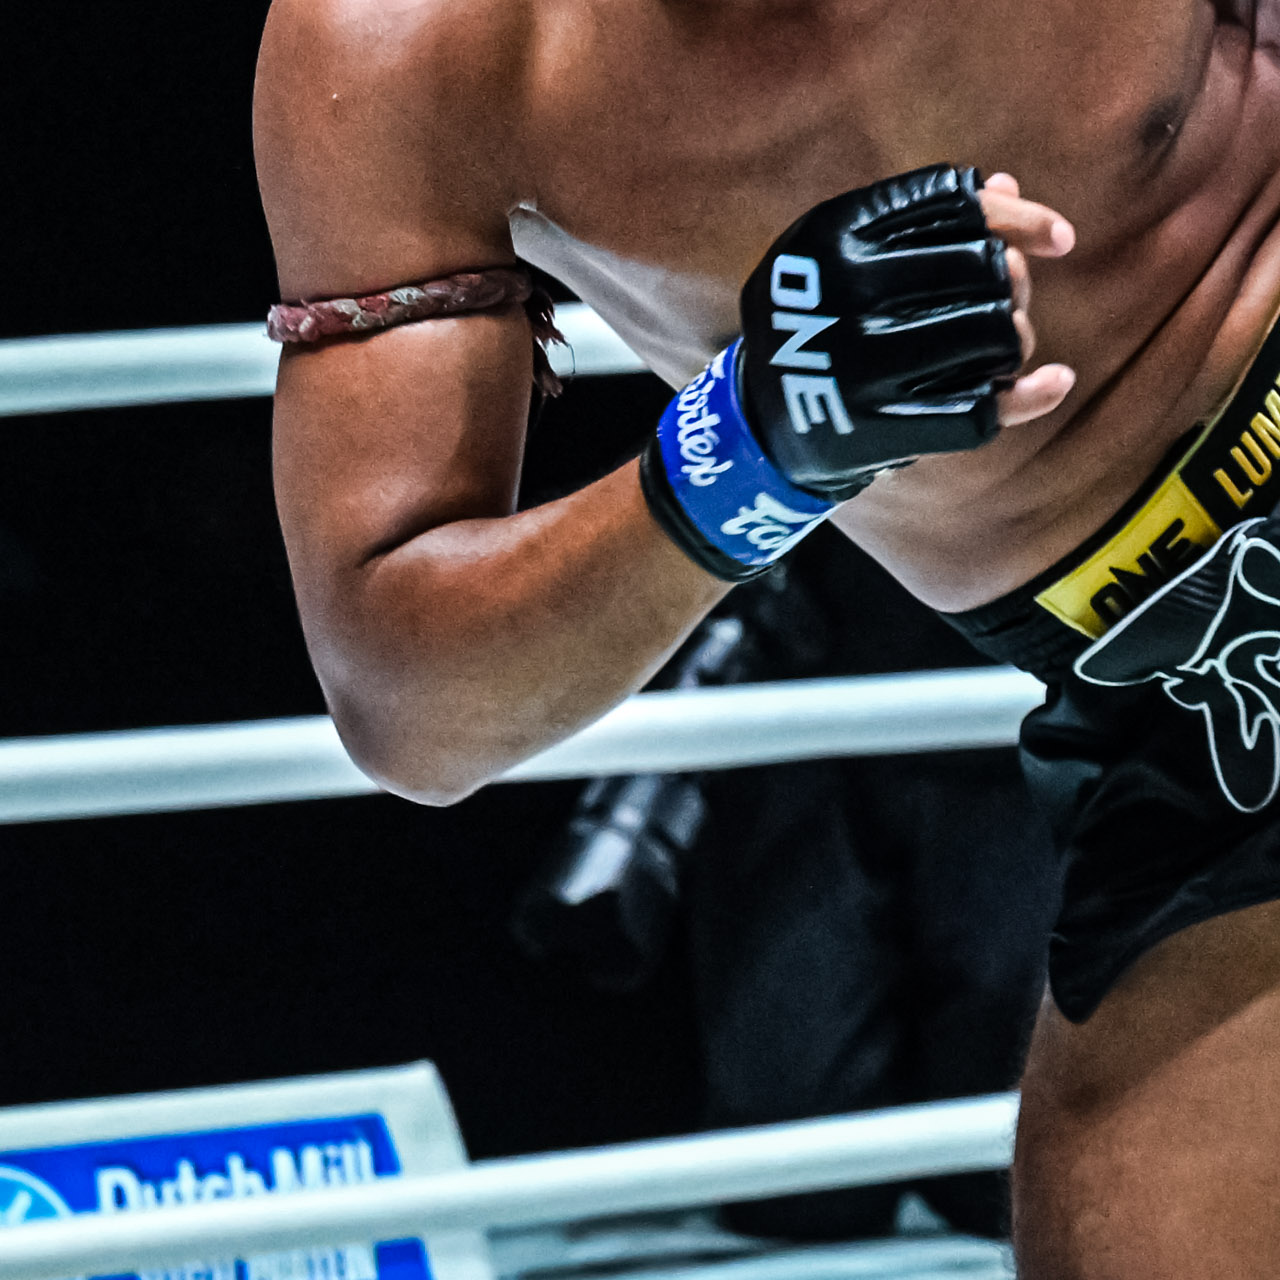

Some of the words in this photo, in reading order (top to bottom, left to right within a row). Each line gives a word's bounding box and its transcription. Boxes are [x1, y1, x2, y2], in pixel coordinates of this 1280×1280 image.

[769, 253, 855, 436] ONE
[1090, 517, 1204, 628] ONE
[96, 1153, 266, 1214] Dutch
[272, 1138, 374, 1191] Mill
